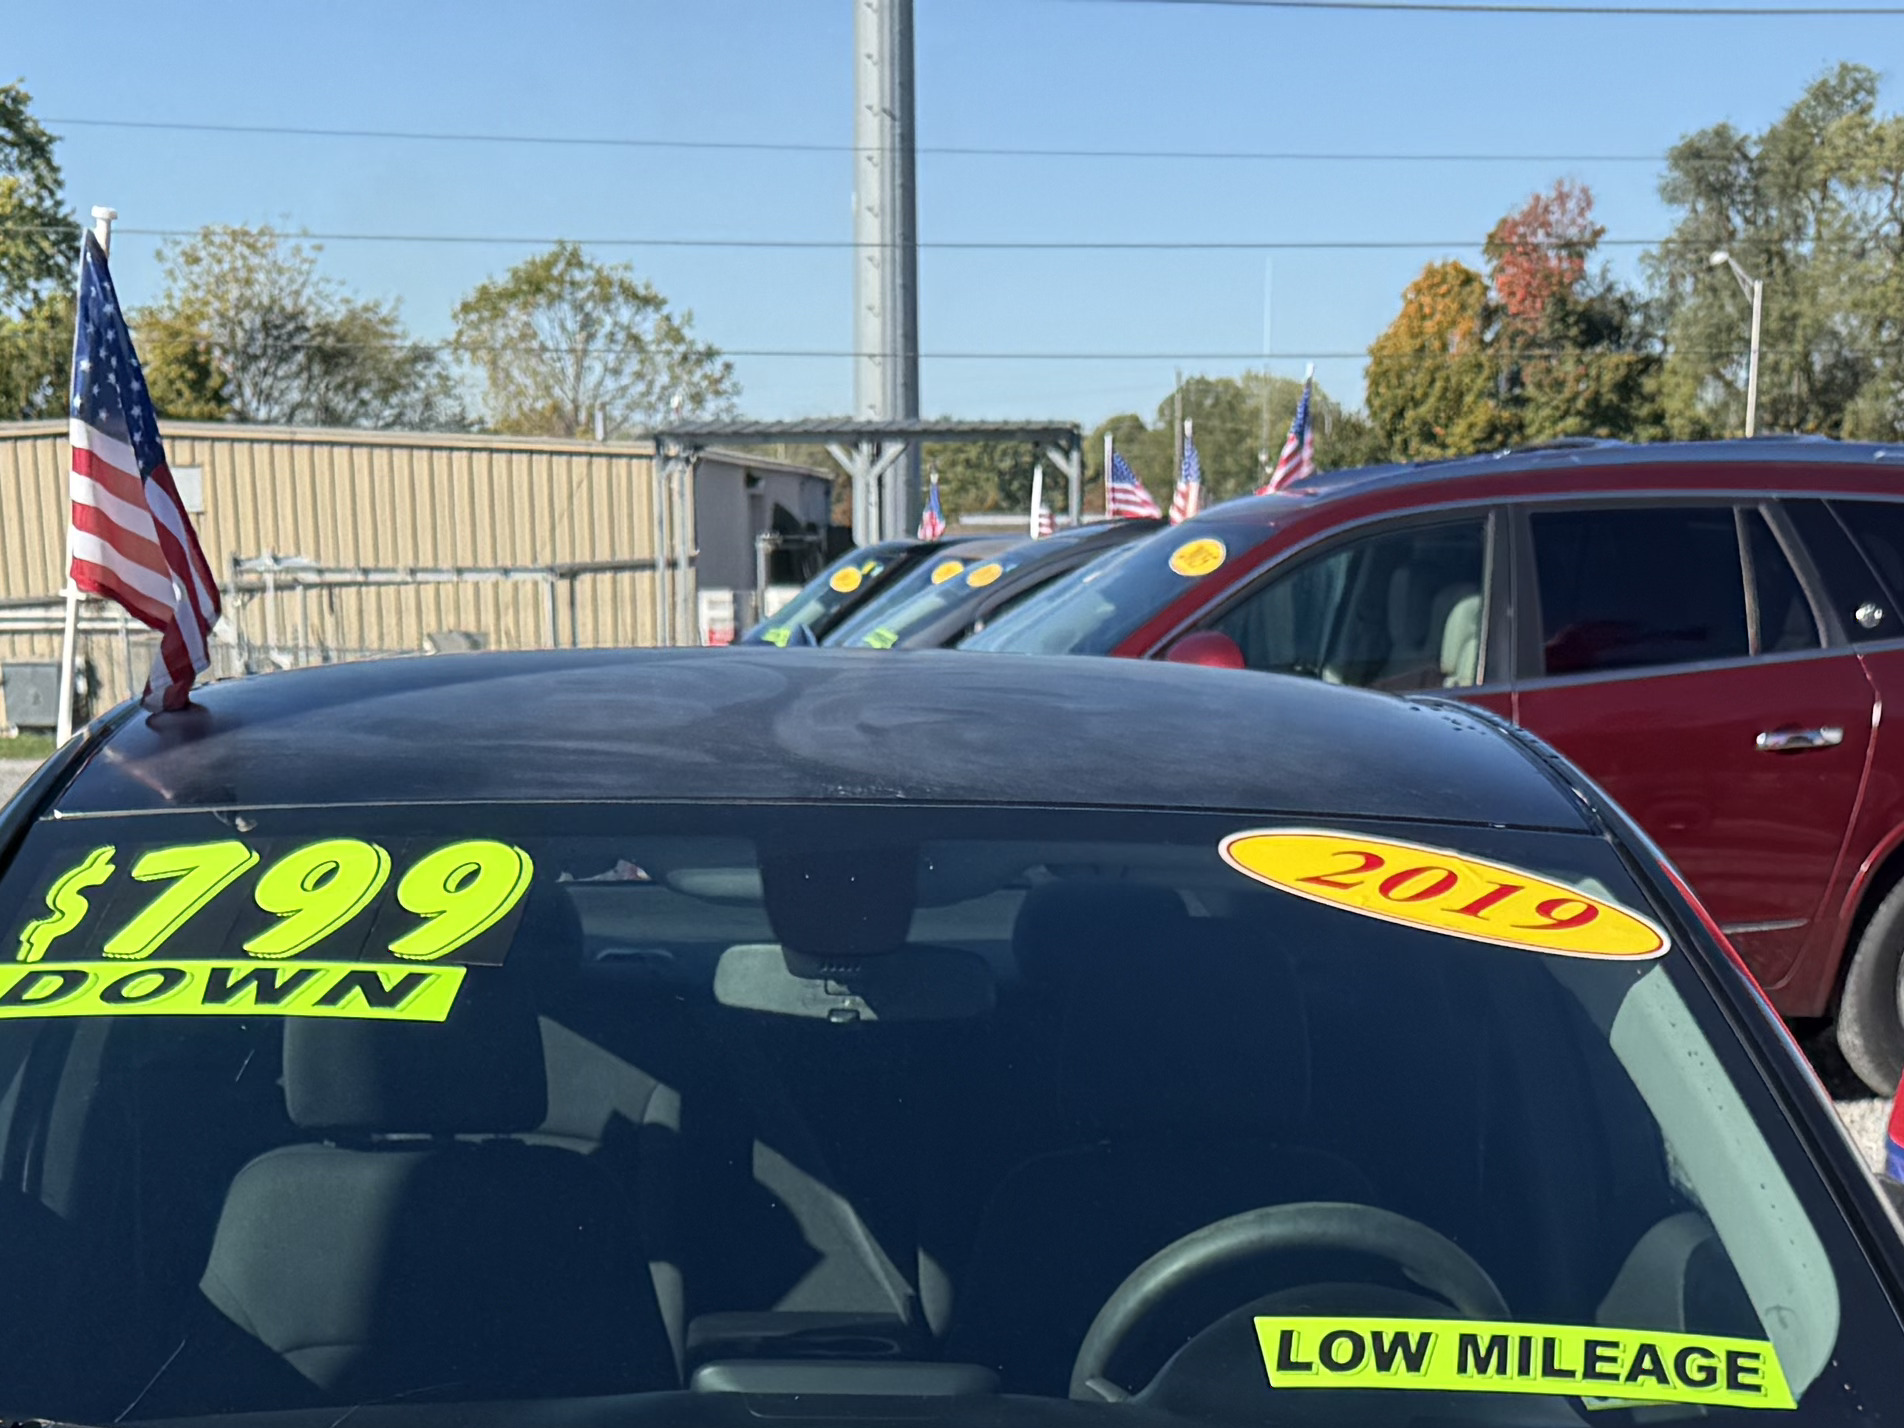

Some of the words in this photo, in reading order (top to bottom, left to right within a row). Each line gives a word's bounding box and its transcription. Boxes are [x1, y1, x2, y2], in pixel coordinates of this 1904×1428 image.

[16, 839, 534, 962] $799
[1298, 850, 1600, 931] 2019
[1275, 1329, 1439, 1375] LOW
[1456, 1332, 1768, 1396] MILEAGE
